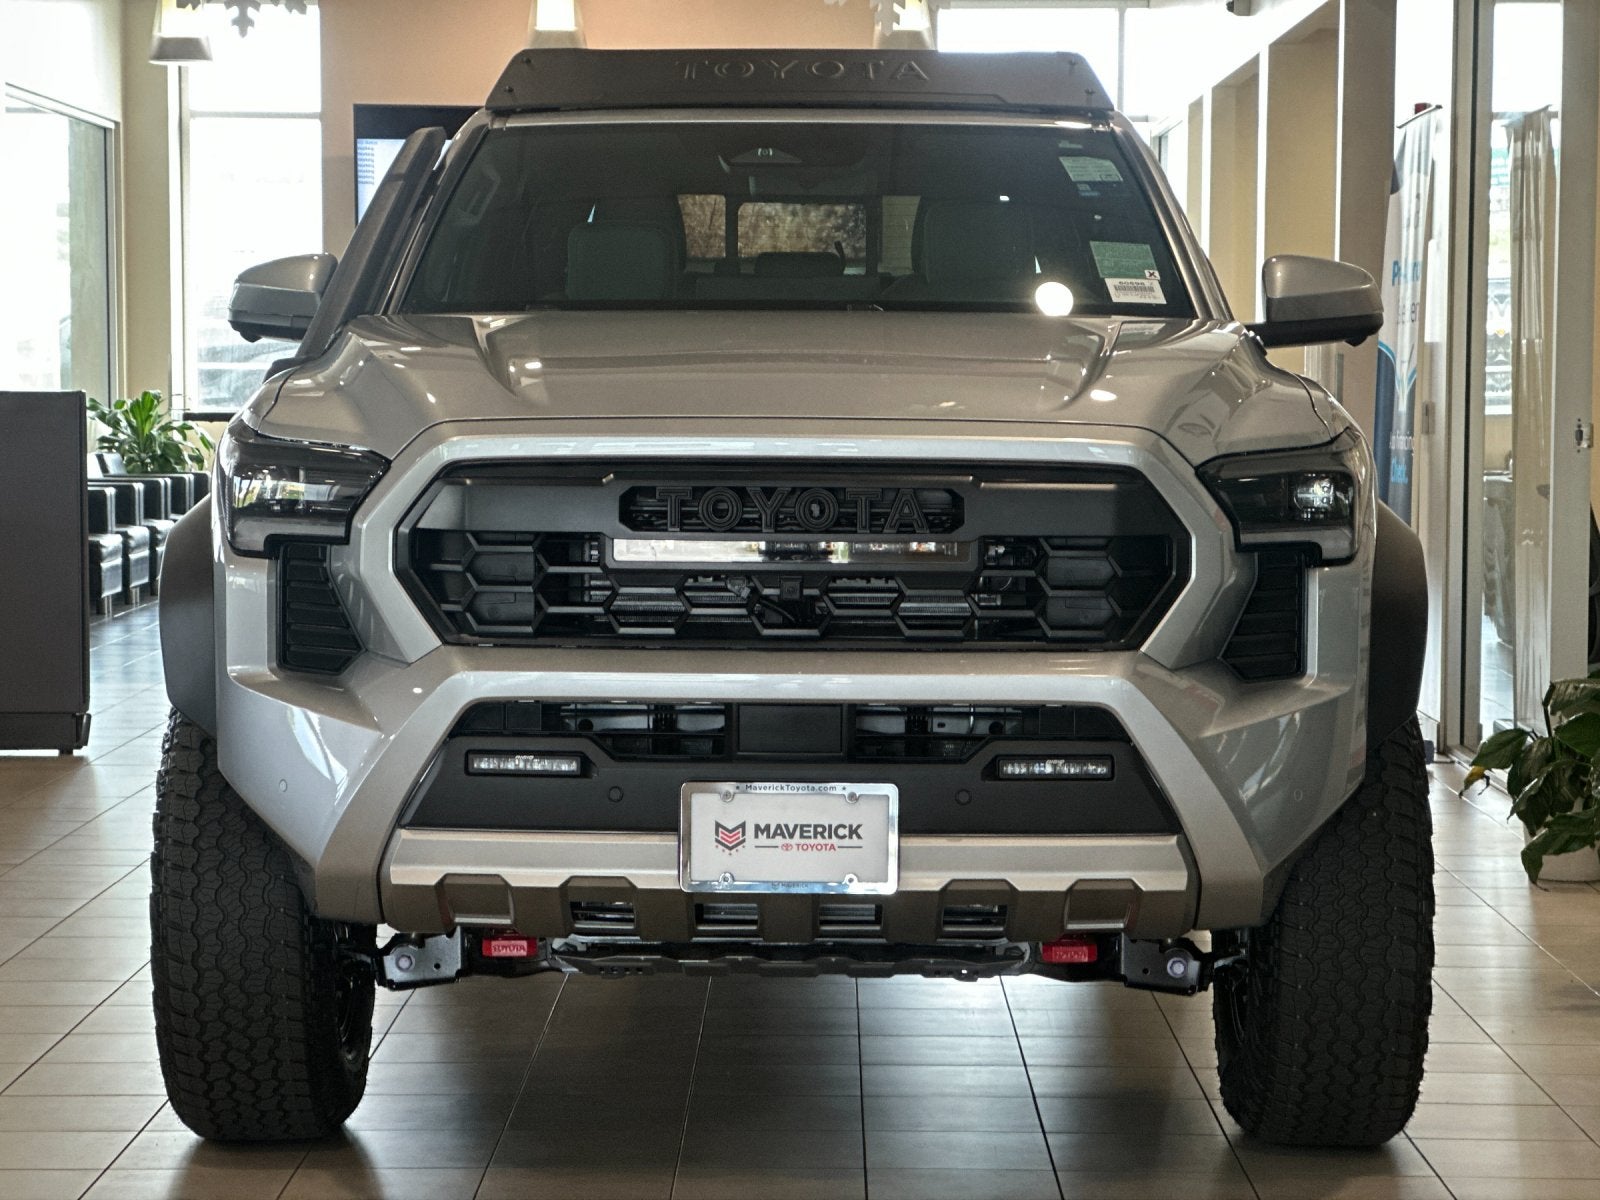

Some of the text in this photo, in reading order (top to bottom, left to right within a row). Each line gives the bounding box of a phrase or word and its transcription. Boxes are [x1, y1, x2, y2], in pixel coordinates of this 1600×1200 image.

[676, 59, 931, 80] TOYOTA
[656, 487, 929, 533] TOYOTA
[745, 784, 837, 793] MaverickToyota.com
[754, 823, 863, 840] MAVERICK
[795, 843, 836, 852] TOYOTA
